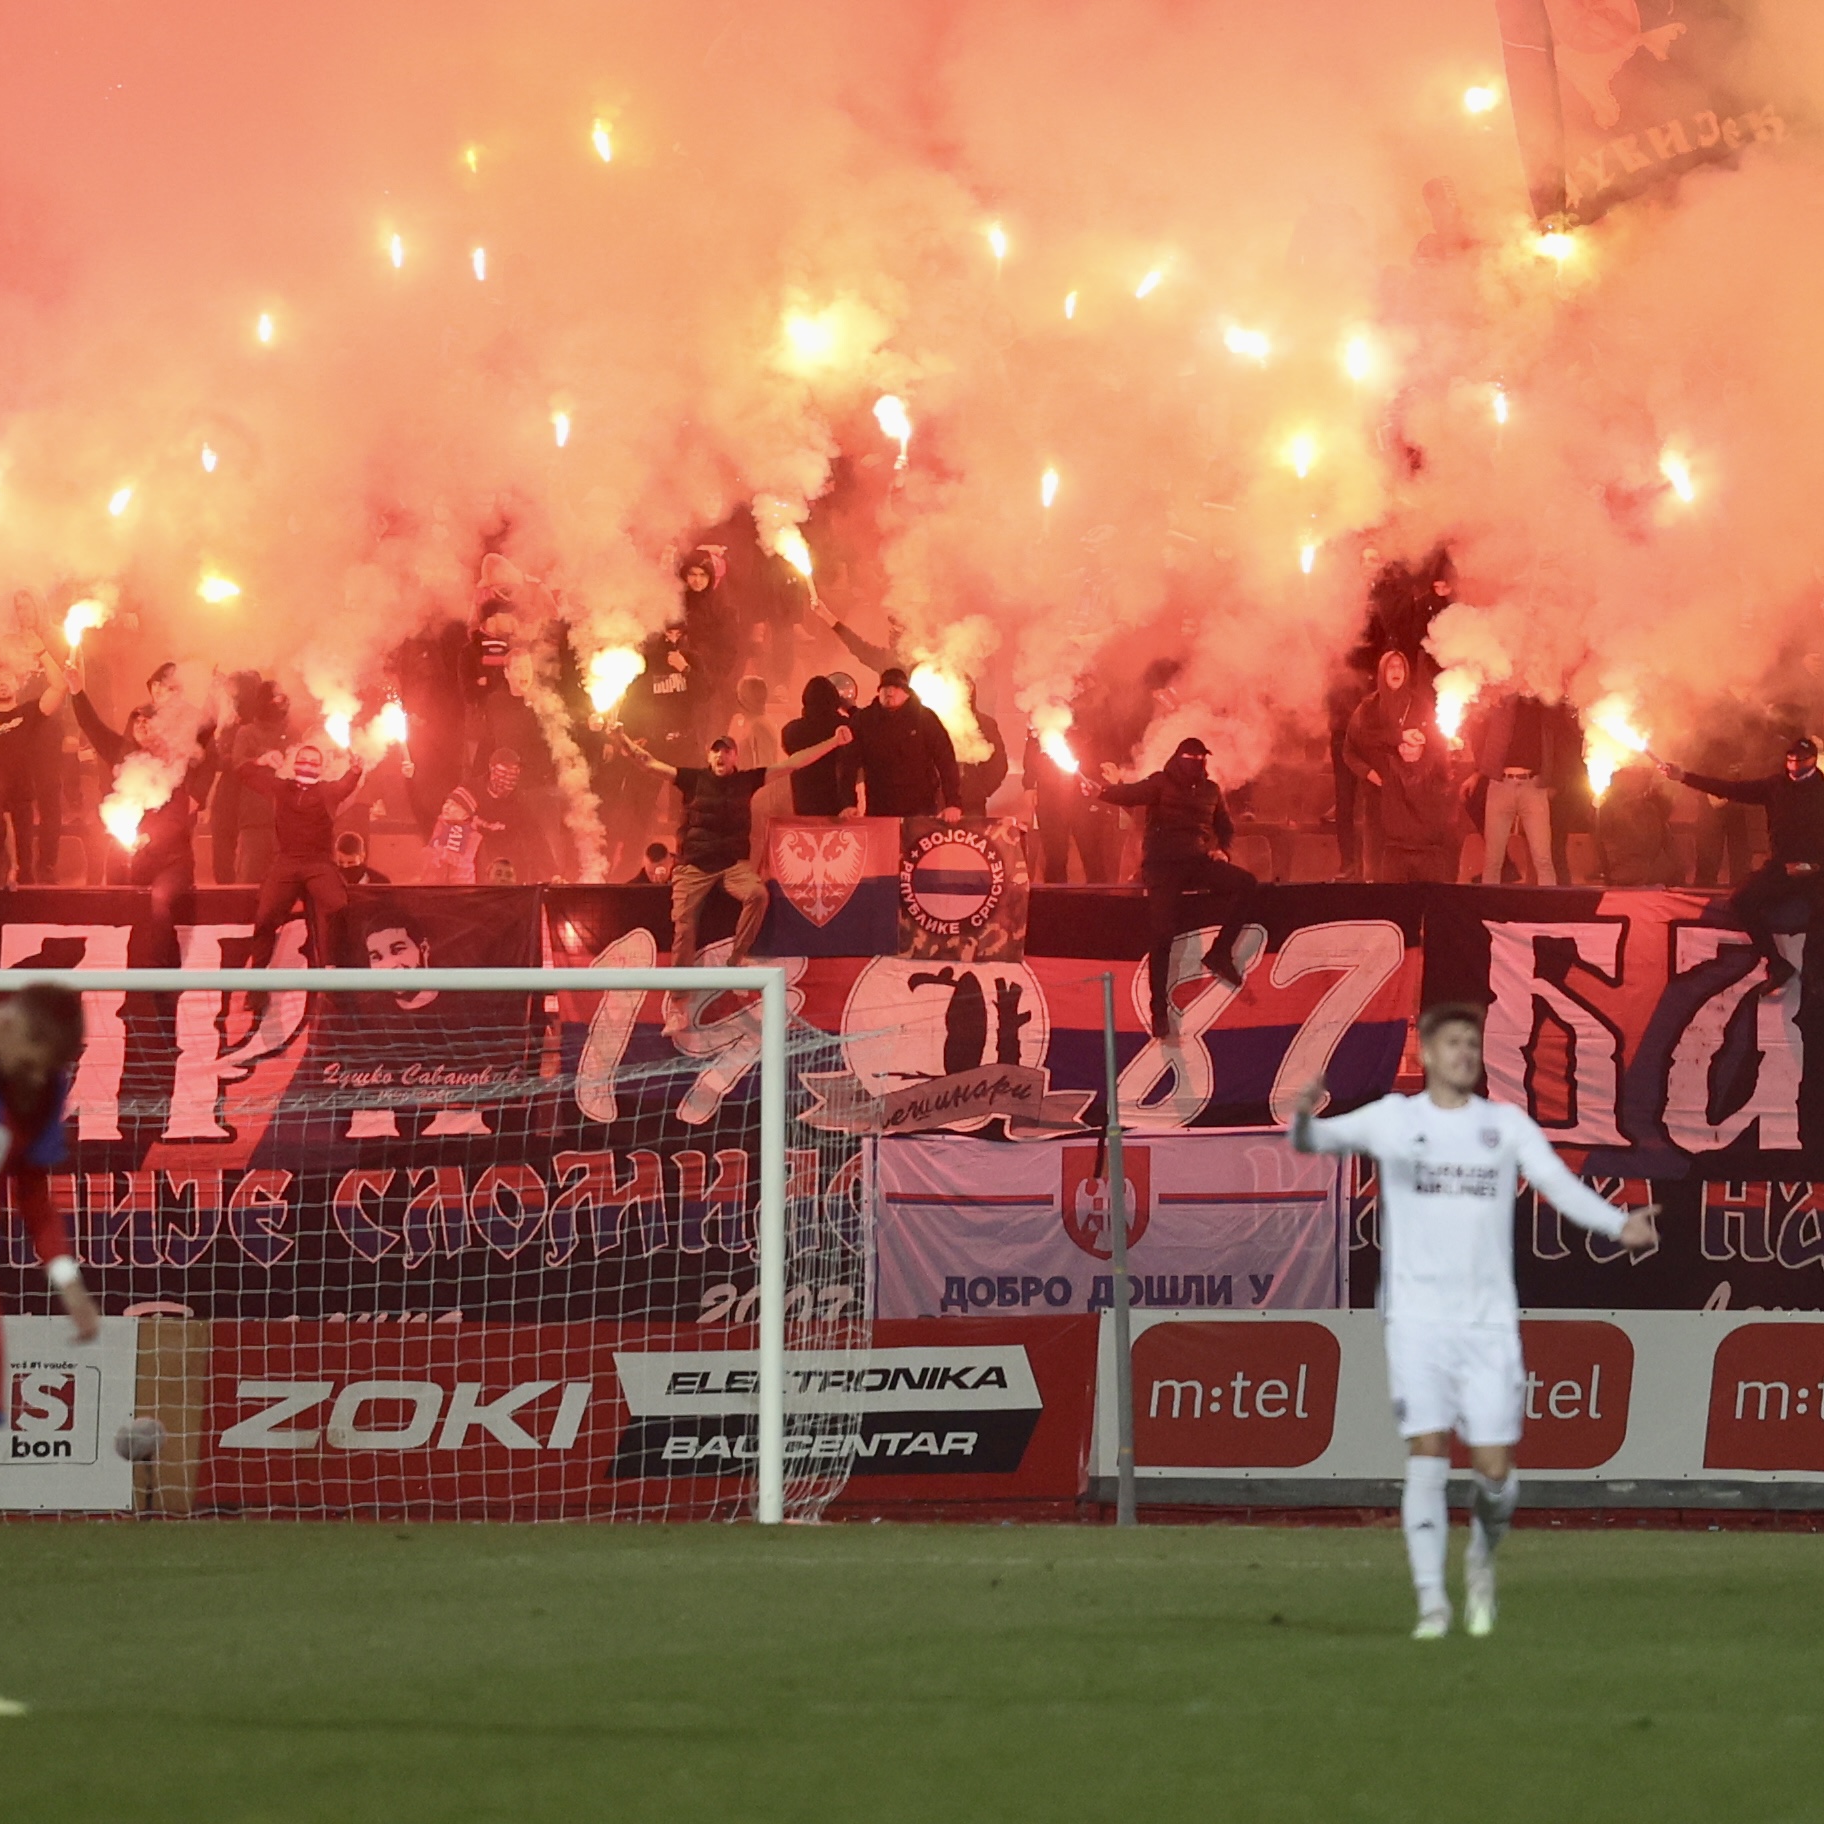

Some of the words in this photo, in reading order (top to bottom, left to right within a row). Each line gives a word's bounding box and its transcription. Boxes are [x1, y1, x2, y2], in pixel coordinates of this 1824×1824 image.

[919, 829, 987, 853] ВОЈСКА
[900, 860, 960, 934] РЕПУБЛИКЕ
[971, 860, 1005, 927] СРПСКЕ
[940, 1276, 1072, 1313] ДОБРО
[1248, 1275, 1276, 1307] У
[218, 1381, 592, 1450] ZOKI
[1149, 1364, 1309, 1420] m:tel
[12, 1435, 72, 1457] bon
